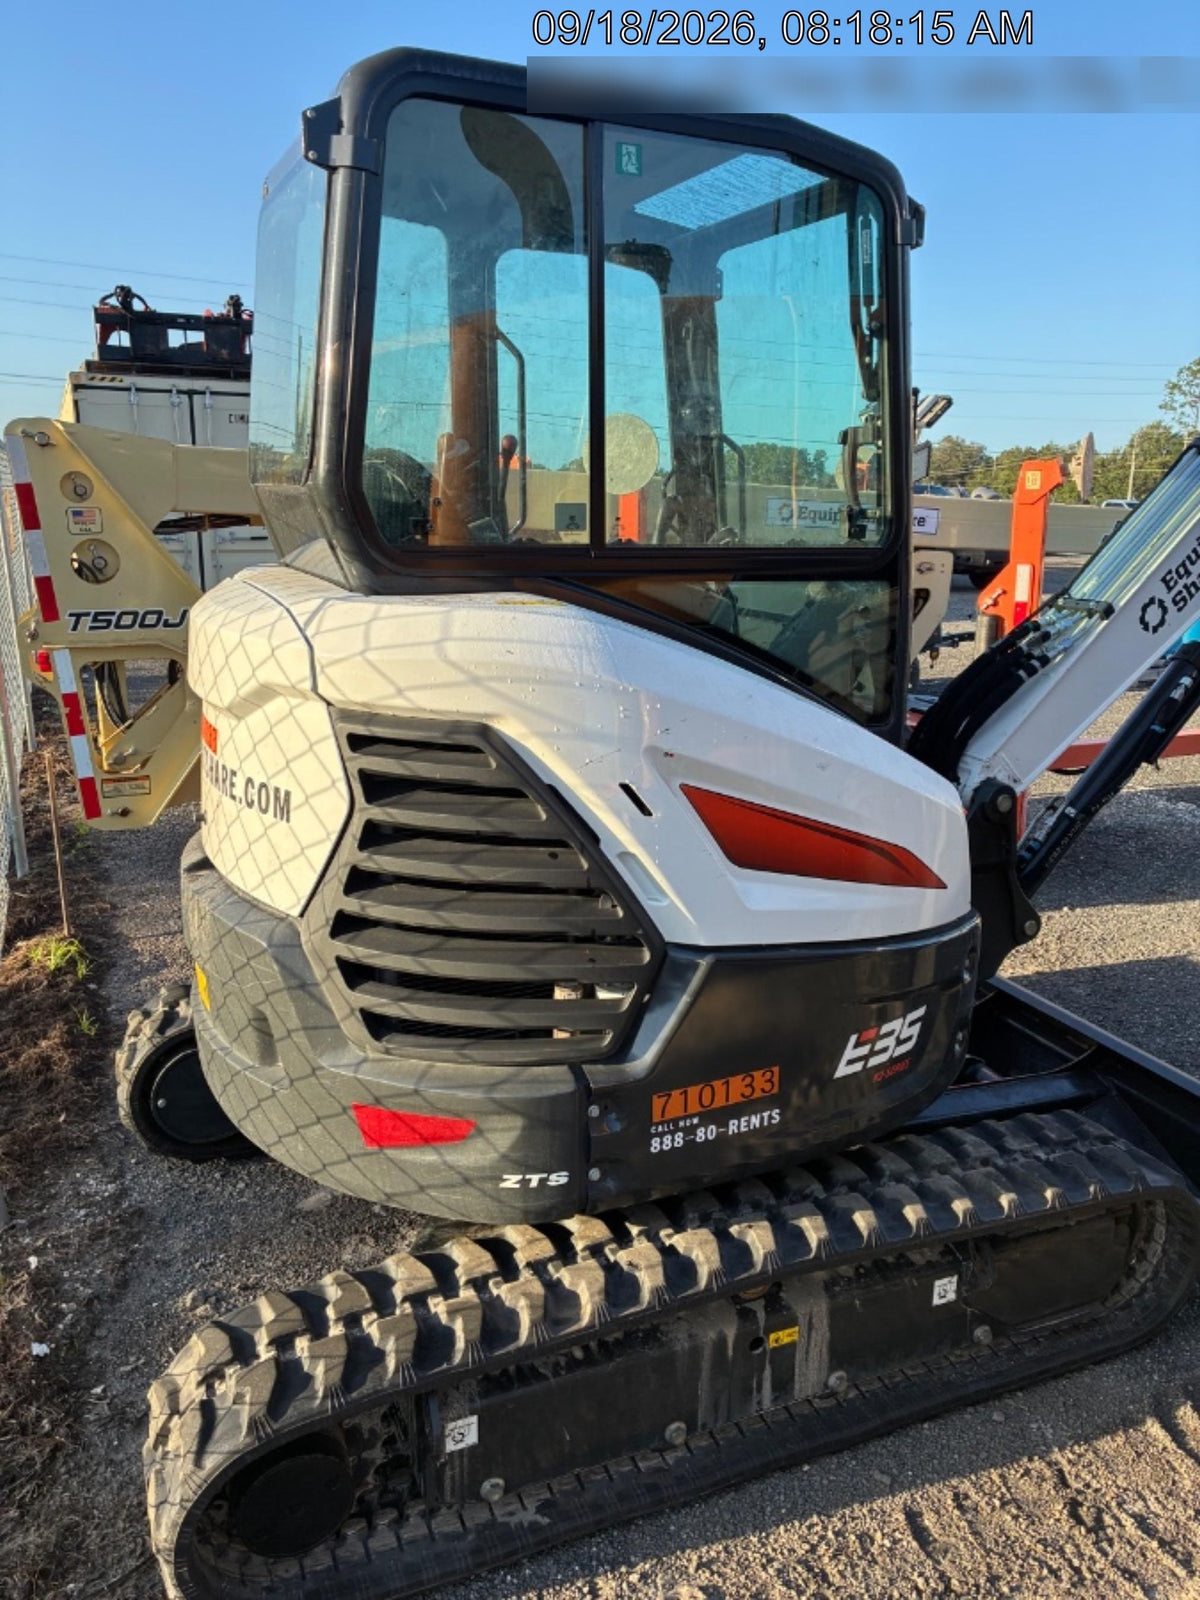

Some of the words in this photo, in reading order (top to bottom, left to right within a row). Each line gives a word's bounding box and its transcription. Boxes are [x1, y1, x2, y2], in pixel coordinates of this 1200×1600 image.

[67, 608, 190, 632] T500J
[833, 1004, 928, 1080] E35
[656, 1069, 776, 1120] 710133
[650, 1124, 675, 1134] CALL
[650, 1108, 781, 1153] 888-80-RENTS
[499, 1170, 571, 1189] ZTS
